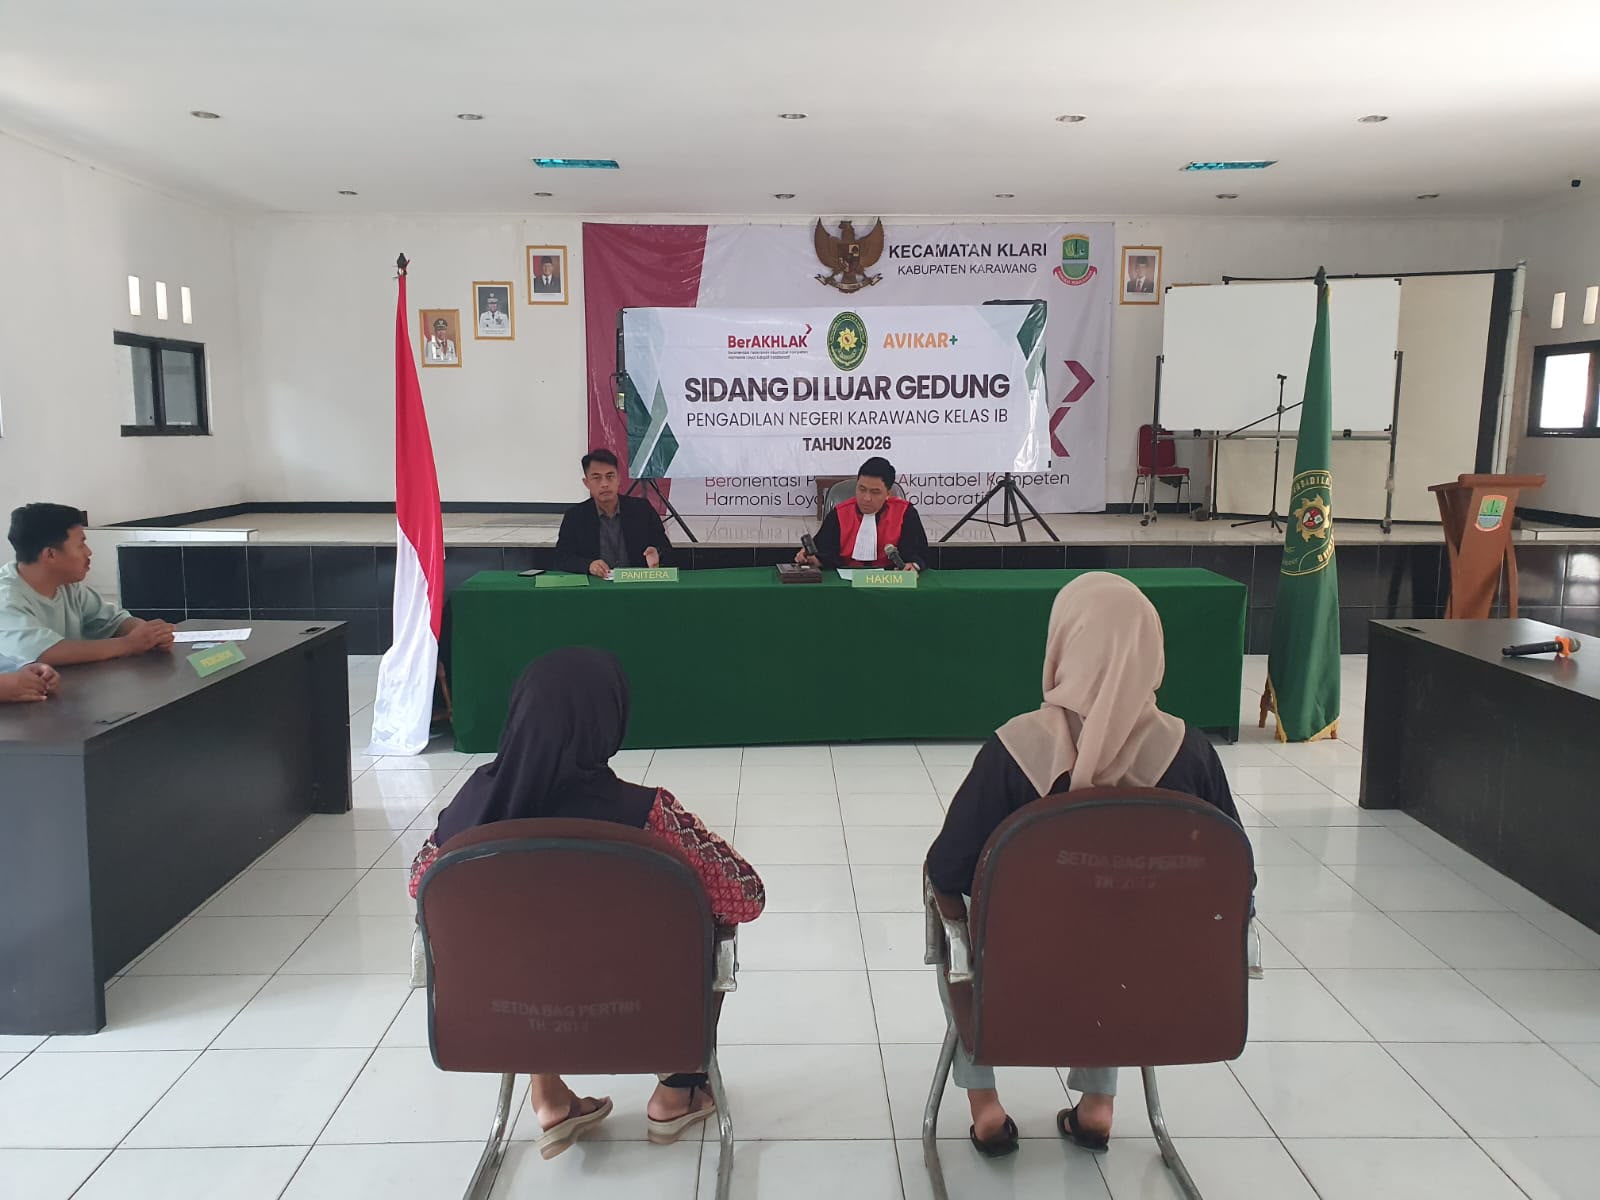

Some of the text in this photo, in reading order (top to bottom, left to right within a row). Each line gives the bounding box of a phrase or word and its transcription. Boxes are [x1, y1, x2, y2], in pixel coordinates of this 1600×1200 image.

[889, 243, 1047, 259] KECAMATAN KLARI
[898, 263, 1037, 276] KABUPATEN KARAWANG
[727, 335, 808, 349] BerAKHLAK
[684, 374, 1010, 402] SIDANG DI LUAR GEDUNG
[687, 408, 1008, 427] PENGADILAN NEGERI KARAWANG KELAS IB
[803, 436, 892, 451] TAHUN 2026
[705, 475, 801, 488] Berorientasi
[898, 472, 981, 487] Akuntabel
[705, 491, 825, 509] Harmonis Loya
[904, 490, 987, 506] olaborati
[621, 571, 671, 580] PANITERA
[865, 574, 903, 584] HAKIM
